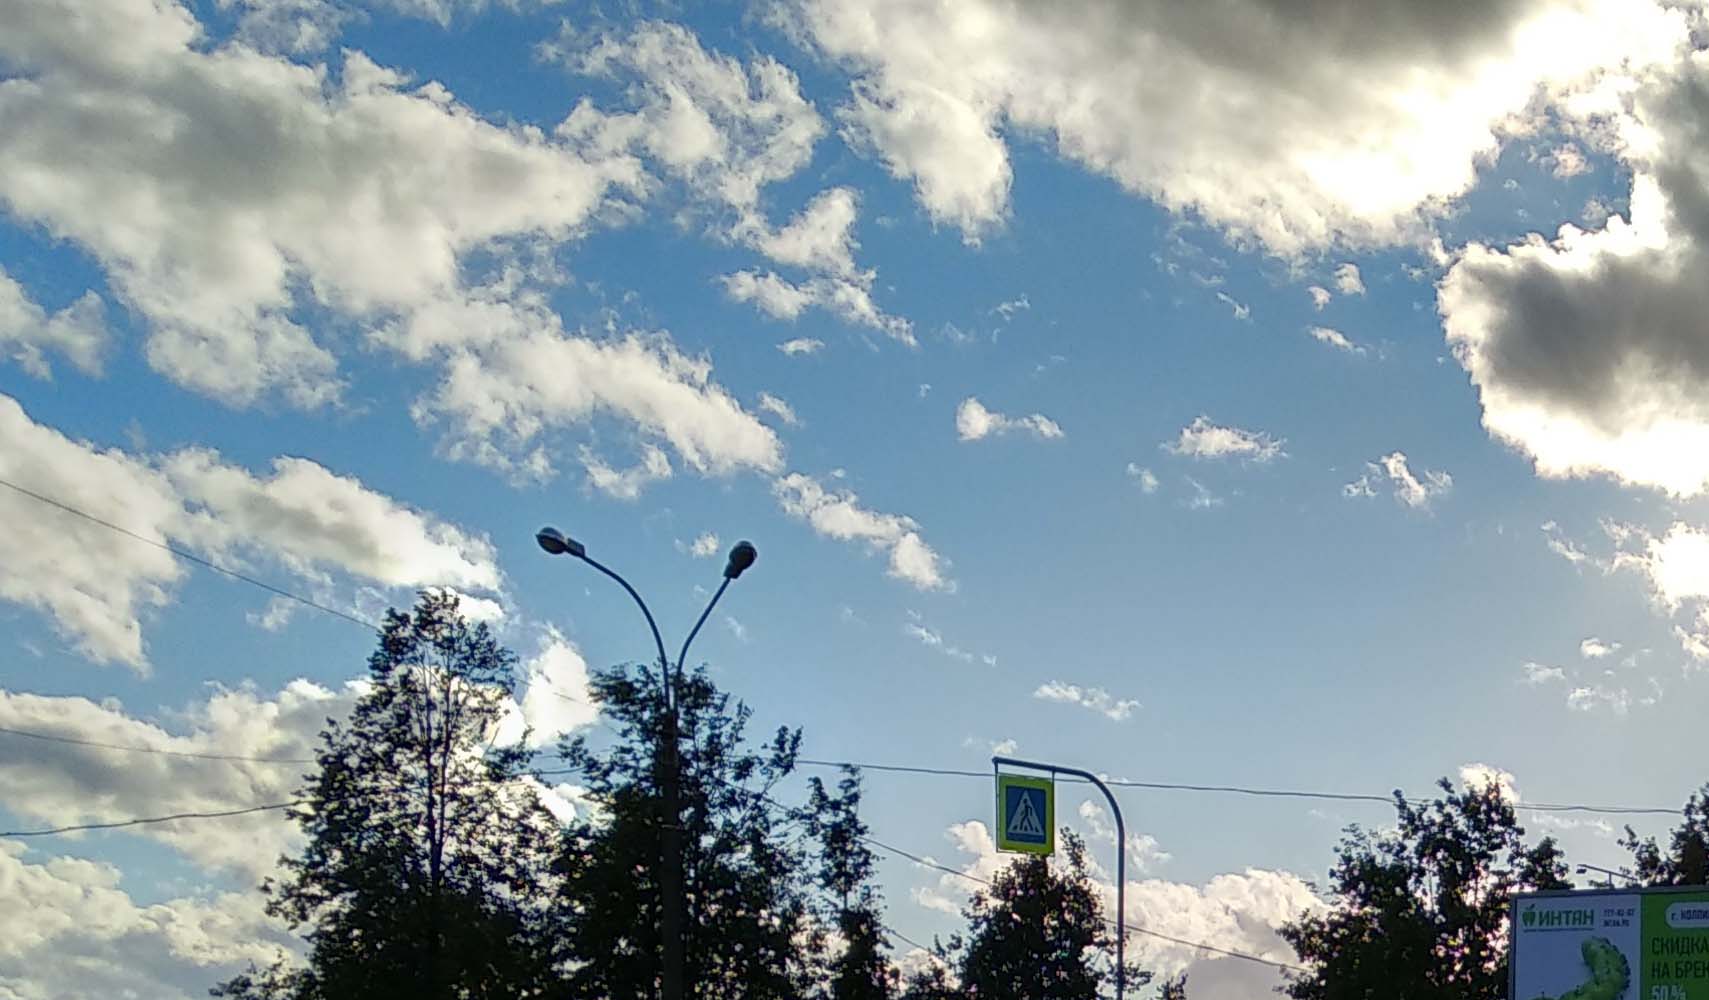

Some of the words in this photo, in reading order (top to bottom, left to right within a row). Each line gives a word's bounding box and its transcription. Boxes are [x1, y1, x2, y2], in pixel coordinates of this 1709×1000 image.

[1538, 908, 1595, 927] ИНТАН
[1651, 936, 1709, 956] СКИДКА
[1651, 961, 1671, 979] НА
